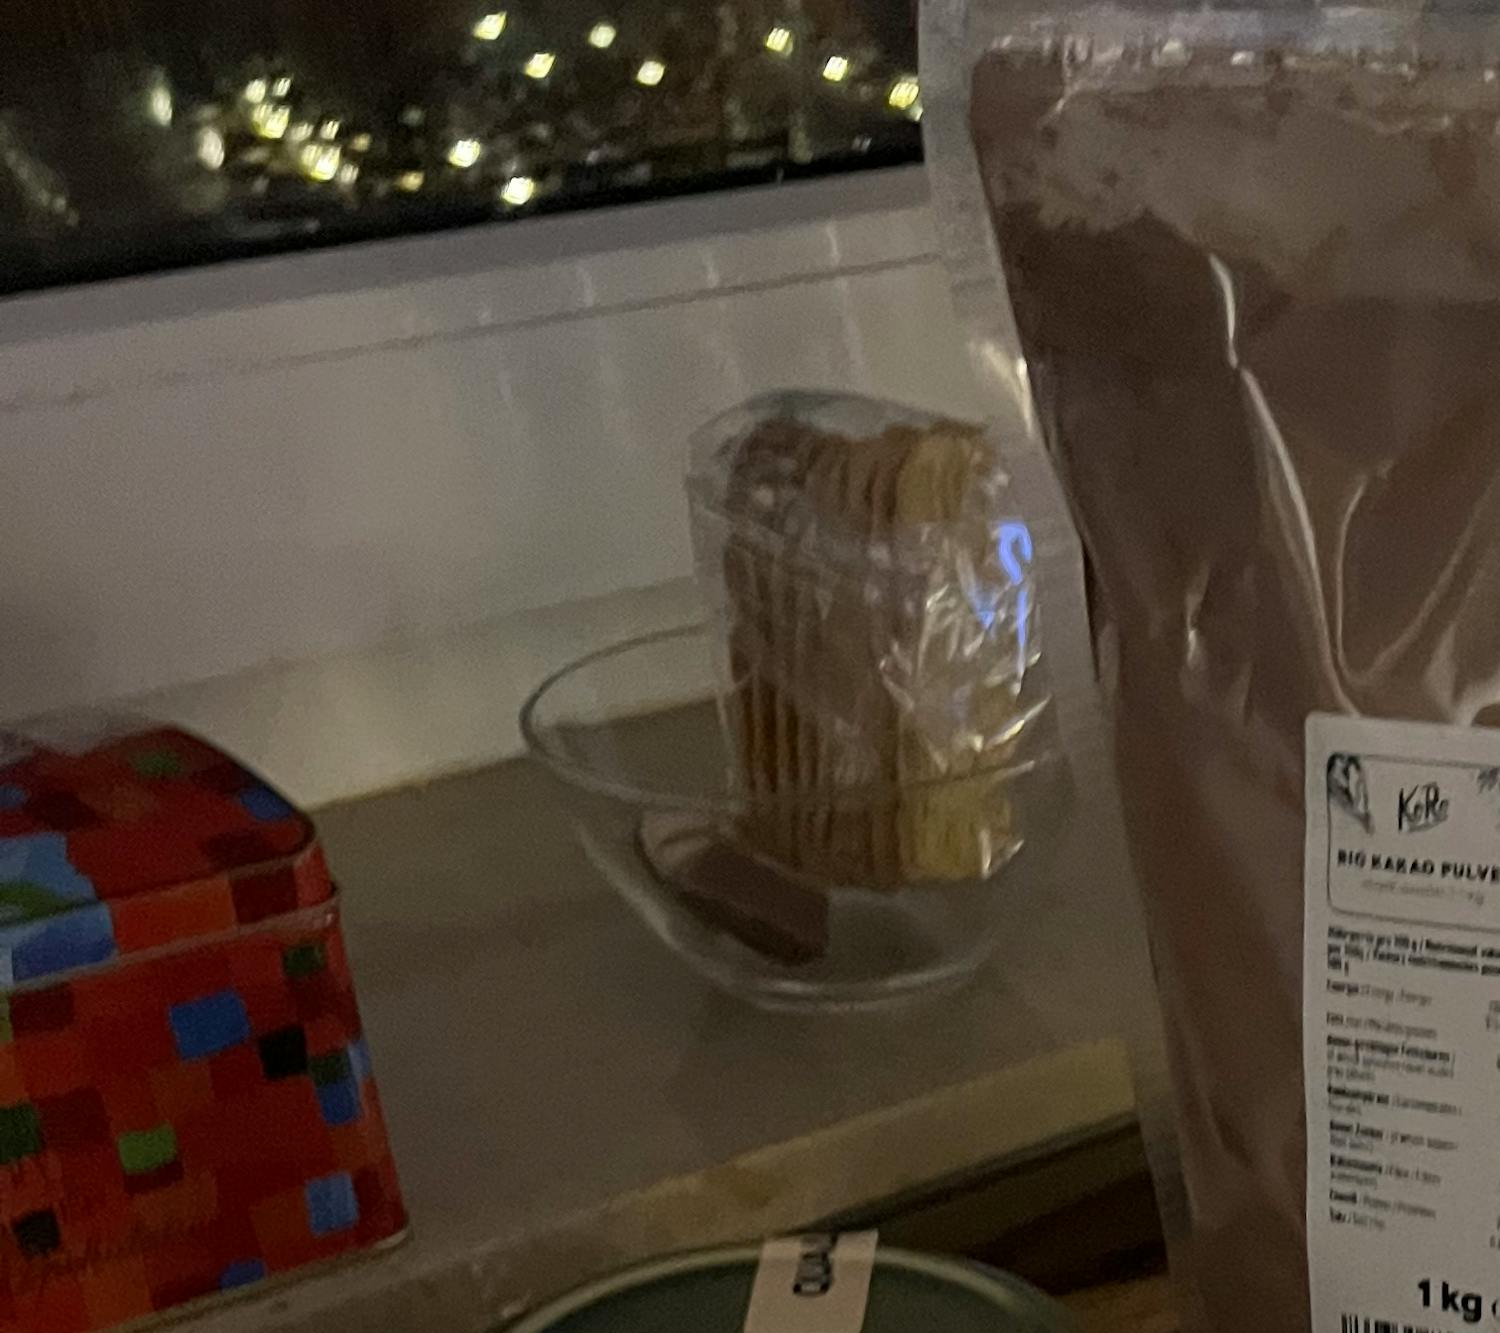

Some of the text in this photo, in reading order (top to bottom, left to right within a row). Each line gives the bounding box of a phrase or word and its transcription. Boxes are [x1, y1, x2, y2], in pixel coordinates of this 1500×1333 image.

[1398, 781, 1450, 833] KoRo
[1371, 853, 1435, 876] KAKAO
[1417, 1277, 1482, 1323] 1 kg
